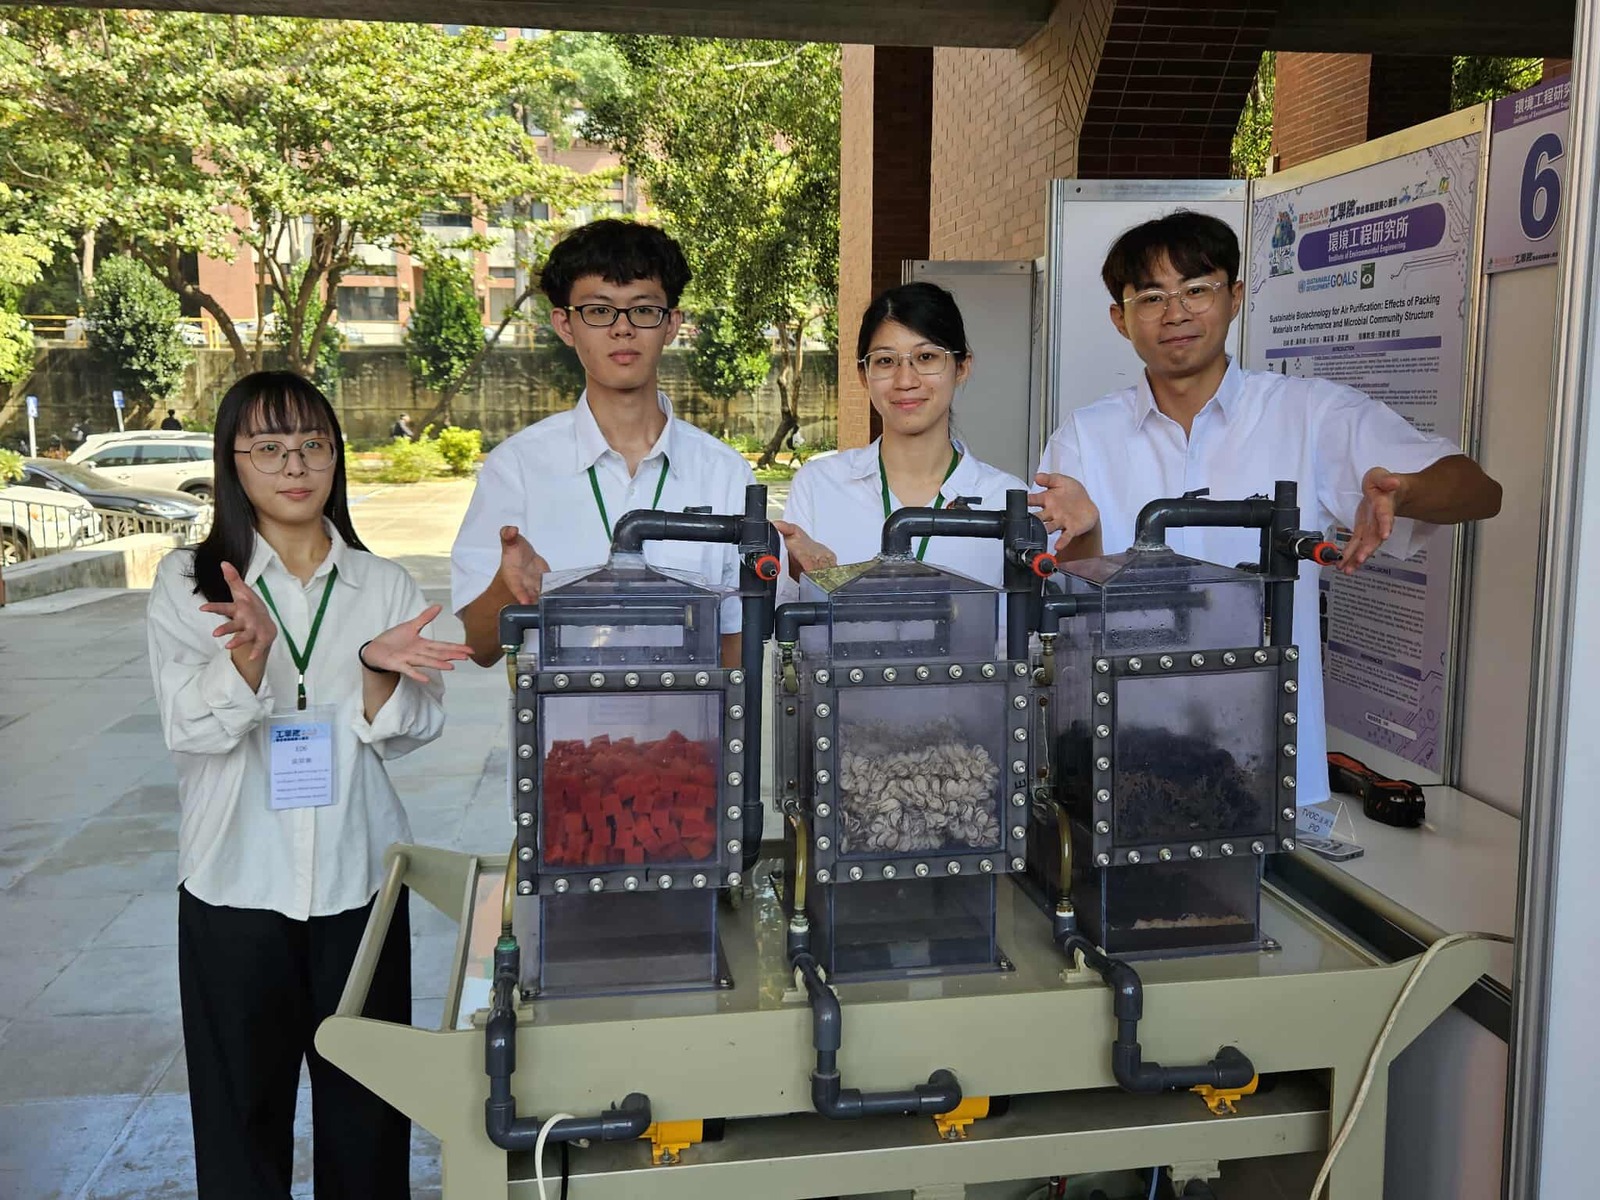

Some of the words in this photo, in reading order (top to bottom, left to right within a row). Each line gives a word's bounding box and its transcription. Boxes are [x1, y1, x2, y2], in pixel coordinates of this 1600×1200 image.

[1520, 132, 1564, 240] 6
[1328, 215, 1409, 252] 環境工程研究所
[1330, 270, 1358, 288] GOALS
[1269, 311, 1295, 323] Sustainable
[1296, 306, 1331, 321] Biotechnology
[1332, 306, 1340, 316] for
[1340, 303, 1349, 314] Air
[1349, 301, 1384, 313] Purification:
[1384, 297, 1406, 309] Effects
[1407, 296, 1414, 306] of
[1414, 294, 1440, 307] Packing
[1272, 324, 1293, 335] Materials
[1301, 320, 1332, 331] Performance
[1333, 319, 1343, 328] and
[1343, 315, 1368, 327] Microbial
[1369, 312, 1403, 325] Community
[1404, 310, 1434, 321] Structure
